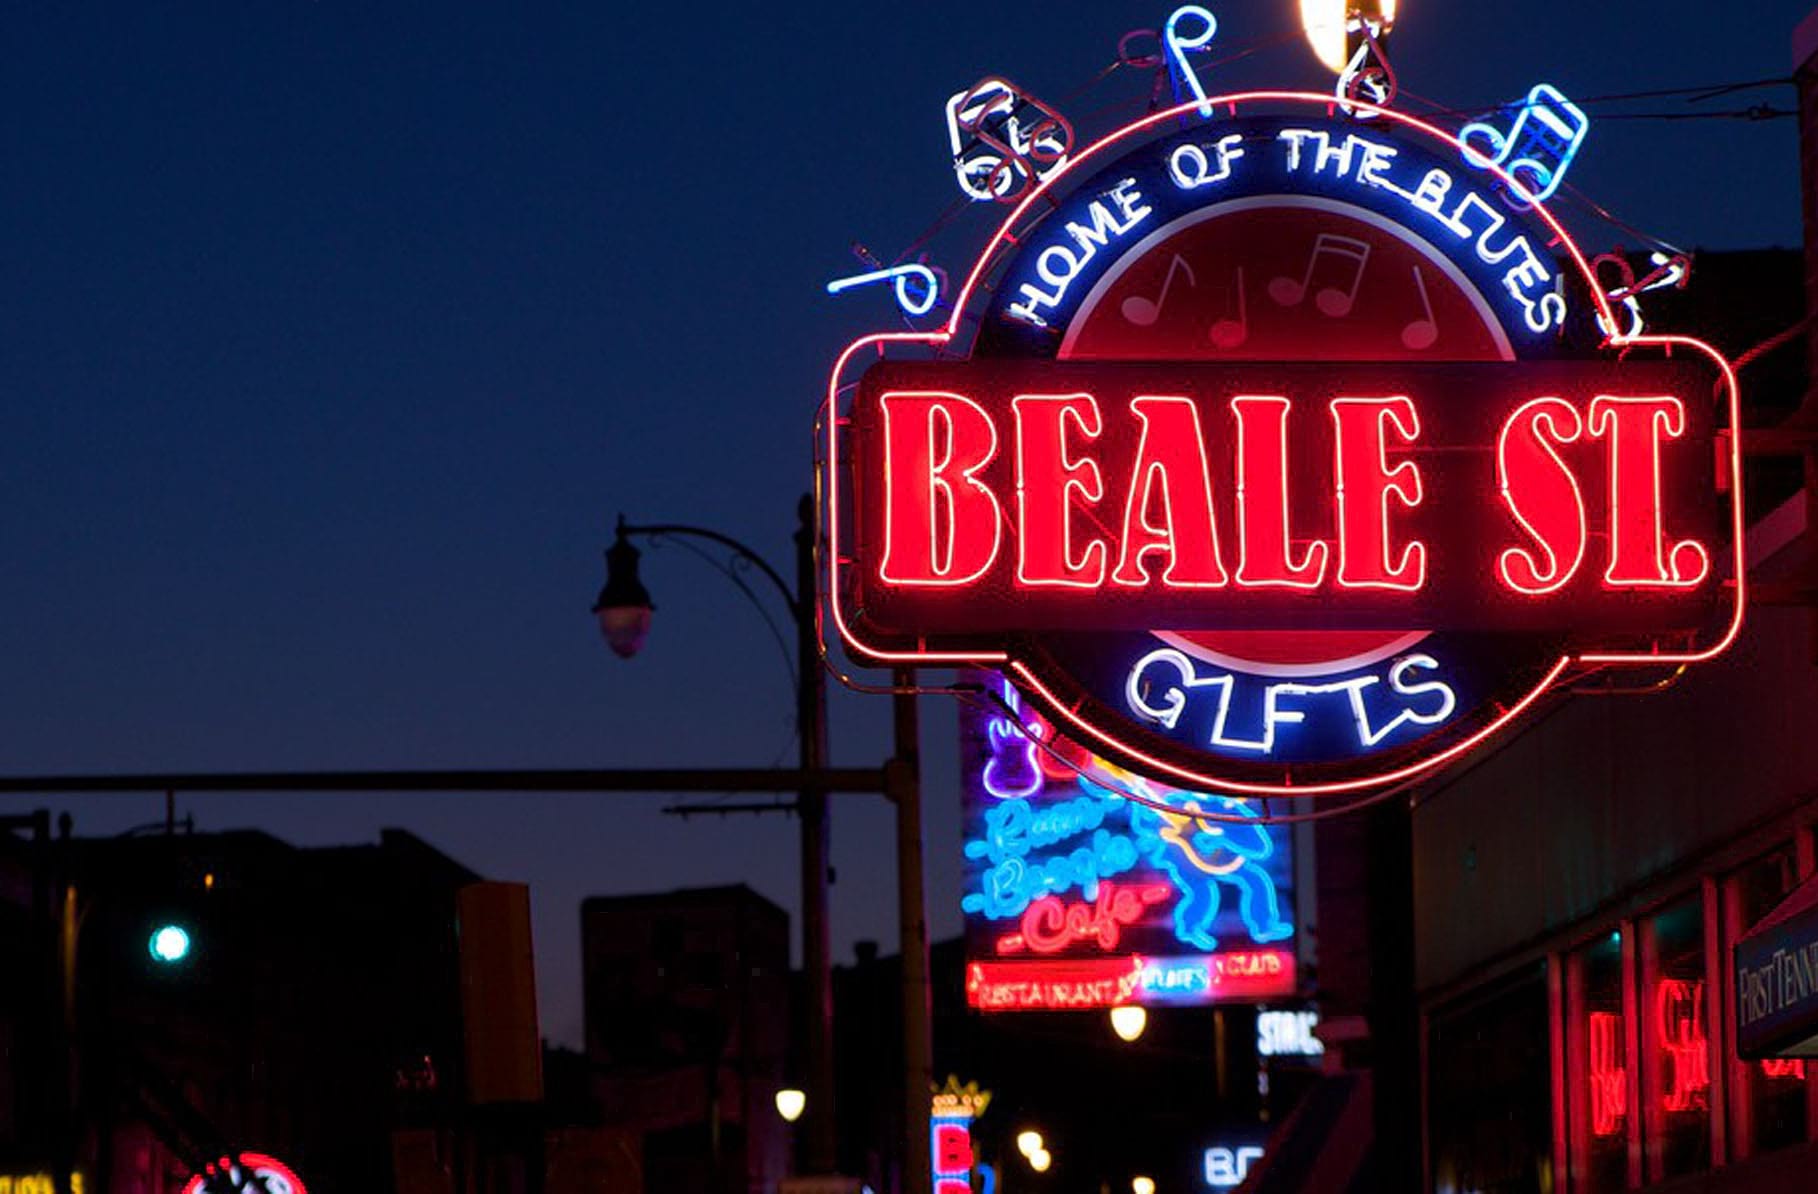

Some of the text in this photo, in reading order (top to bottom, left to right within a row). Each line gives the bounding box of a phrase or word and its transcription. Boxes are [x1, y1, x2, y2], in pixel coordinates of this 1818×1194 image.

[1010, 128, 1567, 334] HOME OF THE BLUES
[878, 390, 1711, 595] BEALE ST.
[1126, 648, 1456, 754] GIFTS
